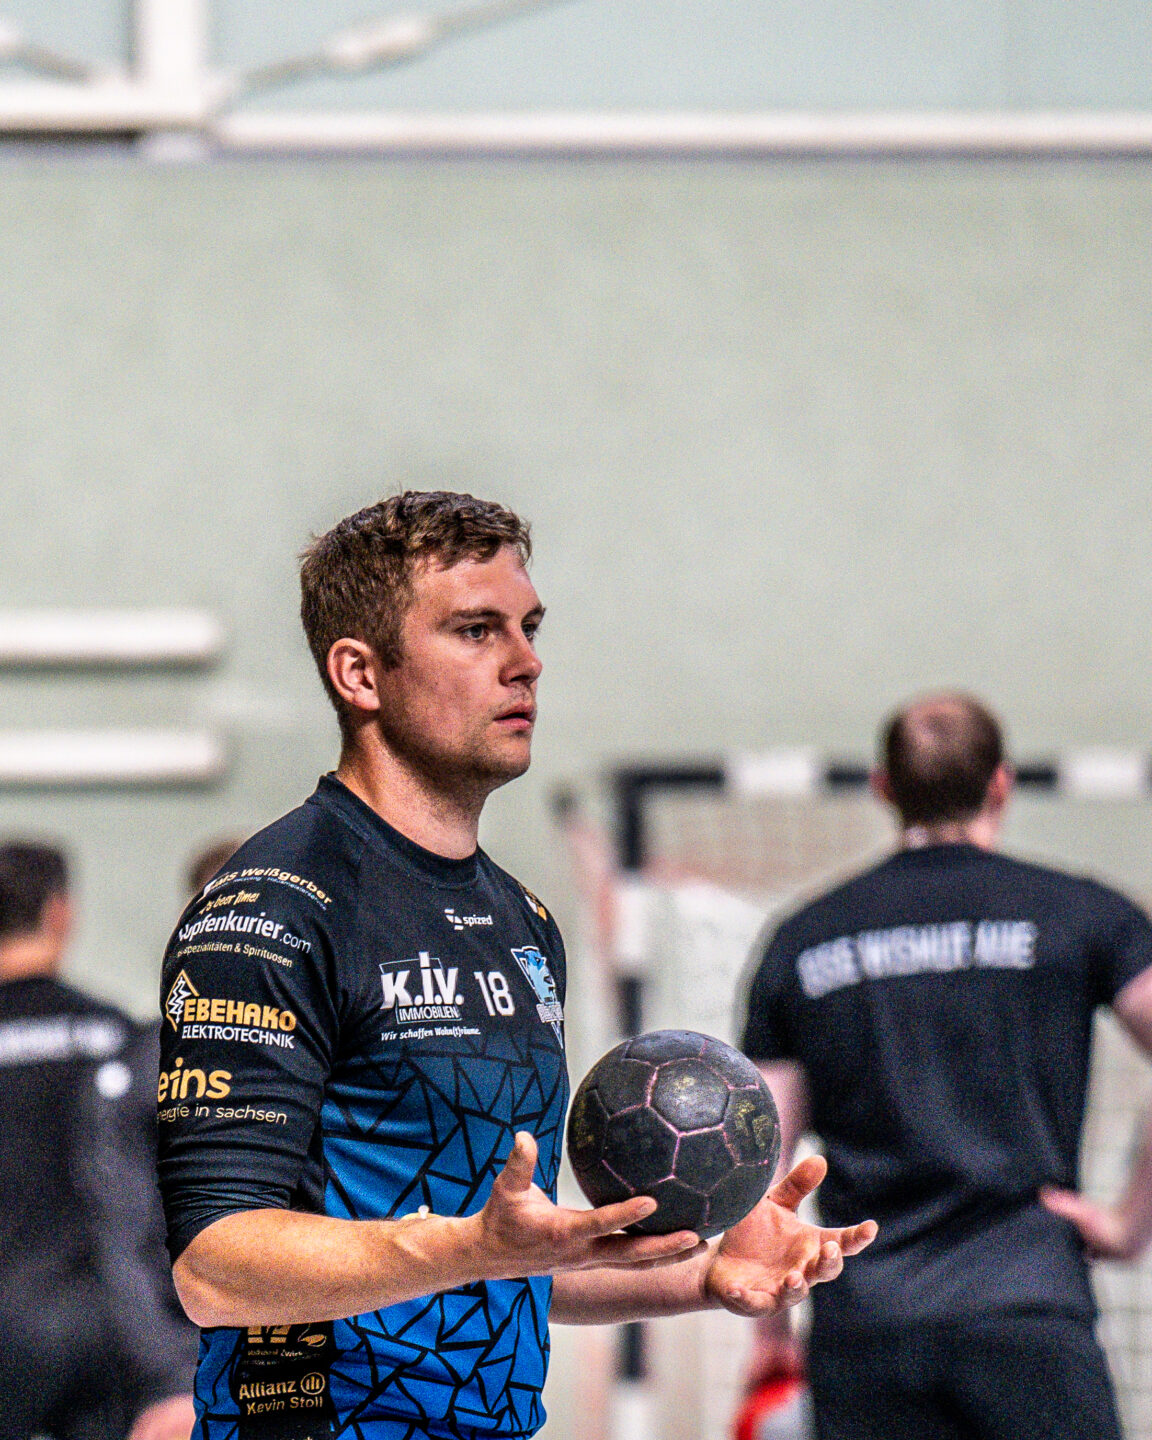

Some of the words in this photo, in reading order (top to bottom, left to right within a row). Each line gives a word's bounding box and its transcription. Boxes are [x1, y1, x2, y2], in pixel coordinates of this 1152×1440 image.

[240, 867, 333, 905] Weißgerber
[462, 913, 494, 927] spized
[234, 942, 241, 953] &
[243, 943, 293, 968] Spirituosen
[473, 970, 516, 1017] 18
[183, 998, 297, 1032] EBEHAKO
[399, 1005, 460, 1023] IMMOBILIEN
[181, 1024, 296, 1050] ELEKTROTECHNIK
[380, 1030, 398, 1042] Wir
[399, 1027, 434, 1041] schaffen
[157, 1056, 233, 1103] eins
[194, 1103, 210, 1118] in
[215, 1105, 288, 1125] sachsen
[239, 1380, 298, 1400] Allianz
[246, 1398, 285, 1415] Kevin
[289, 1396, 323, 1409] Stoll
